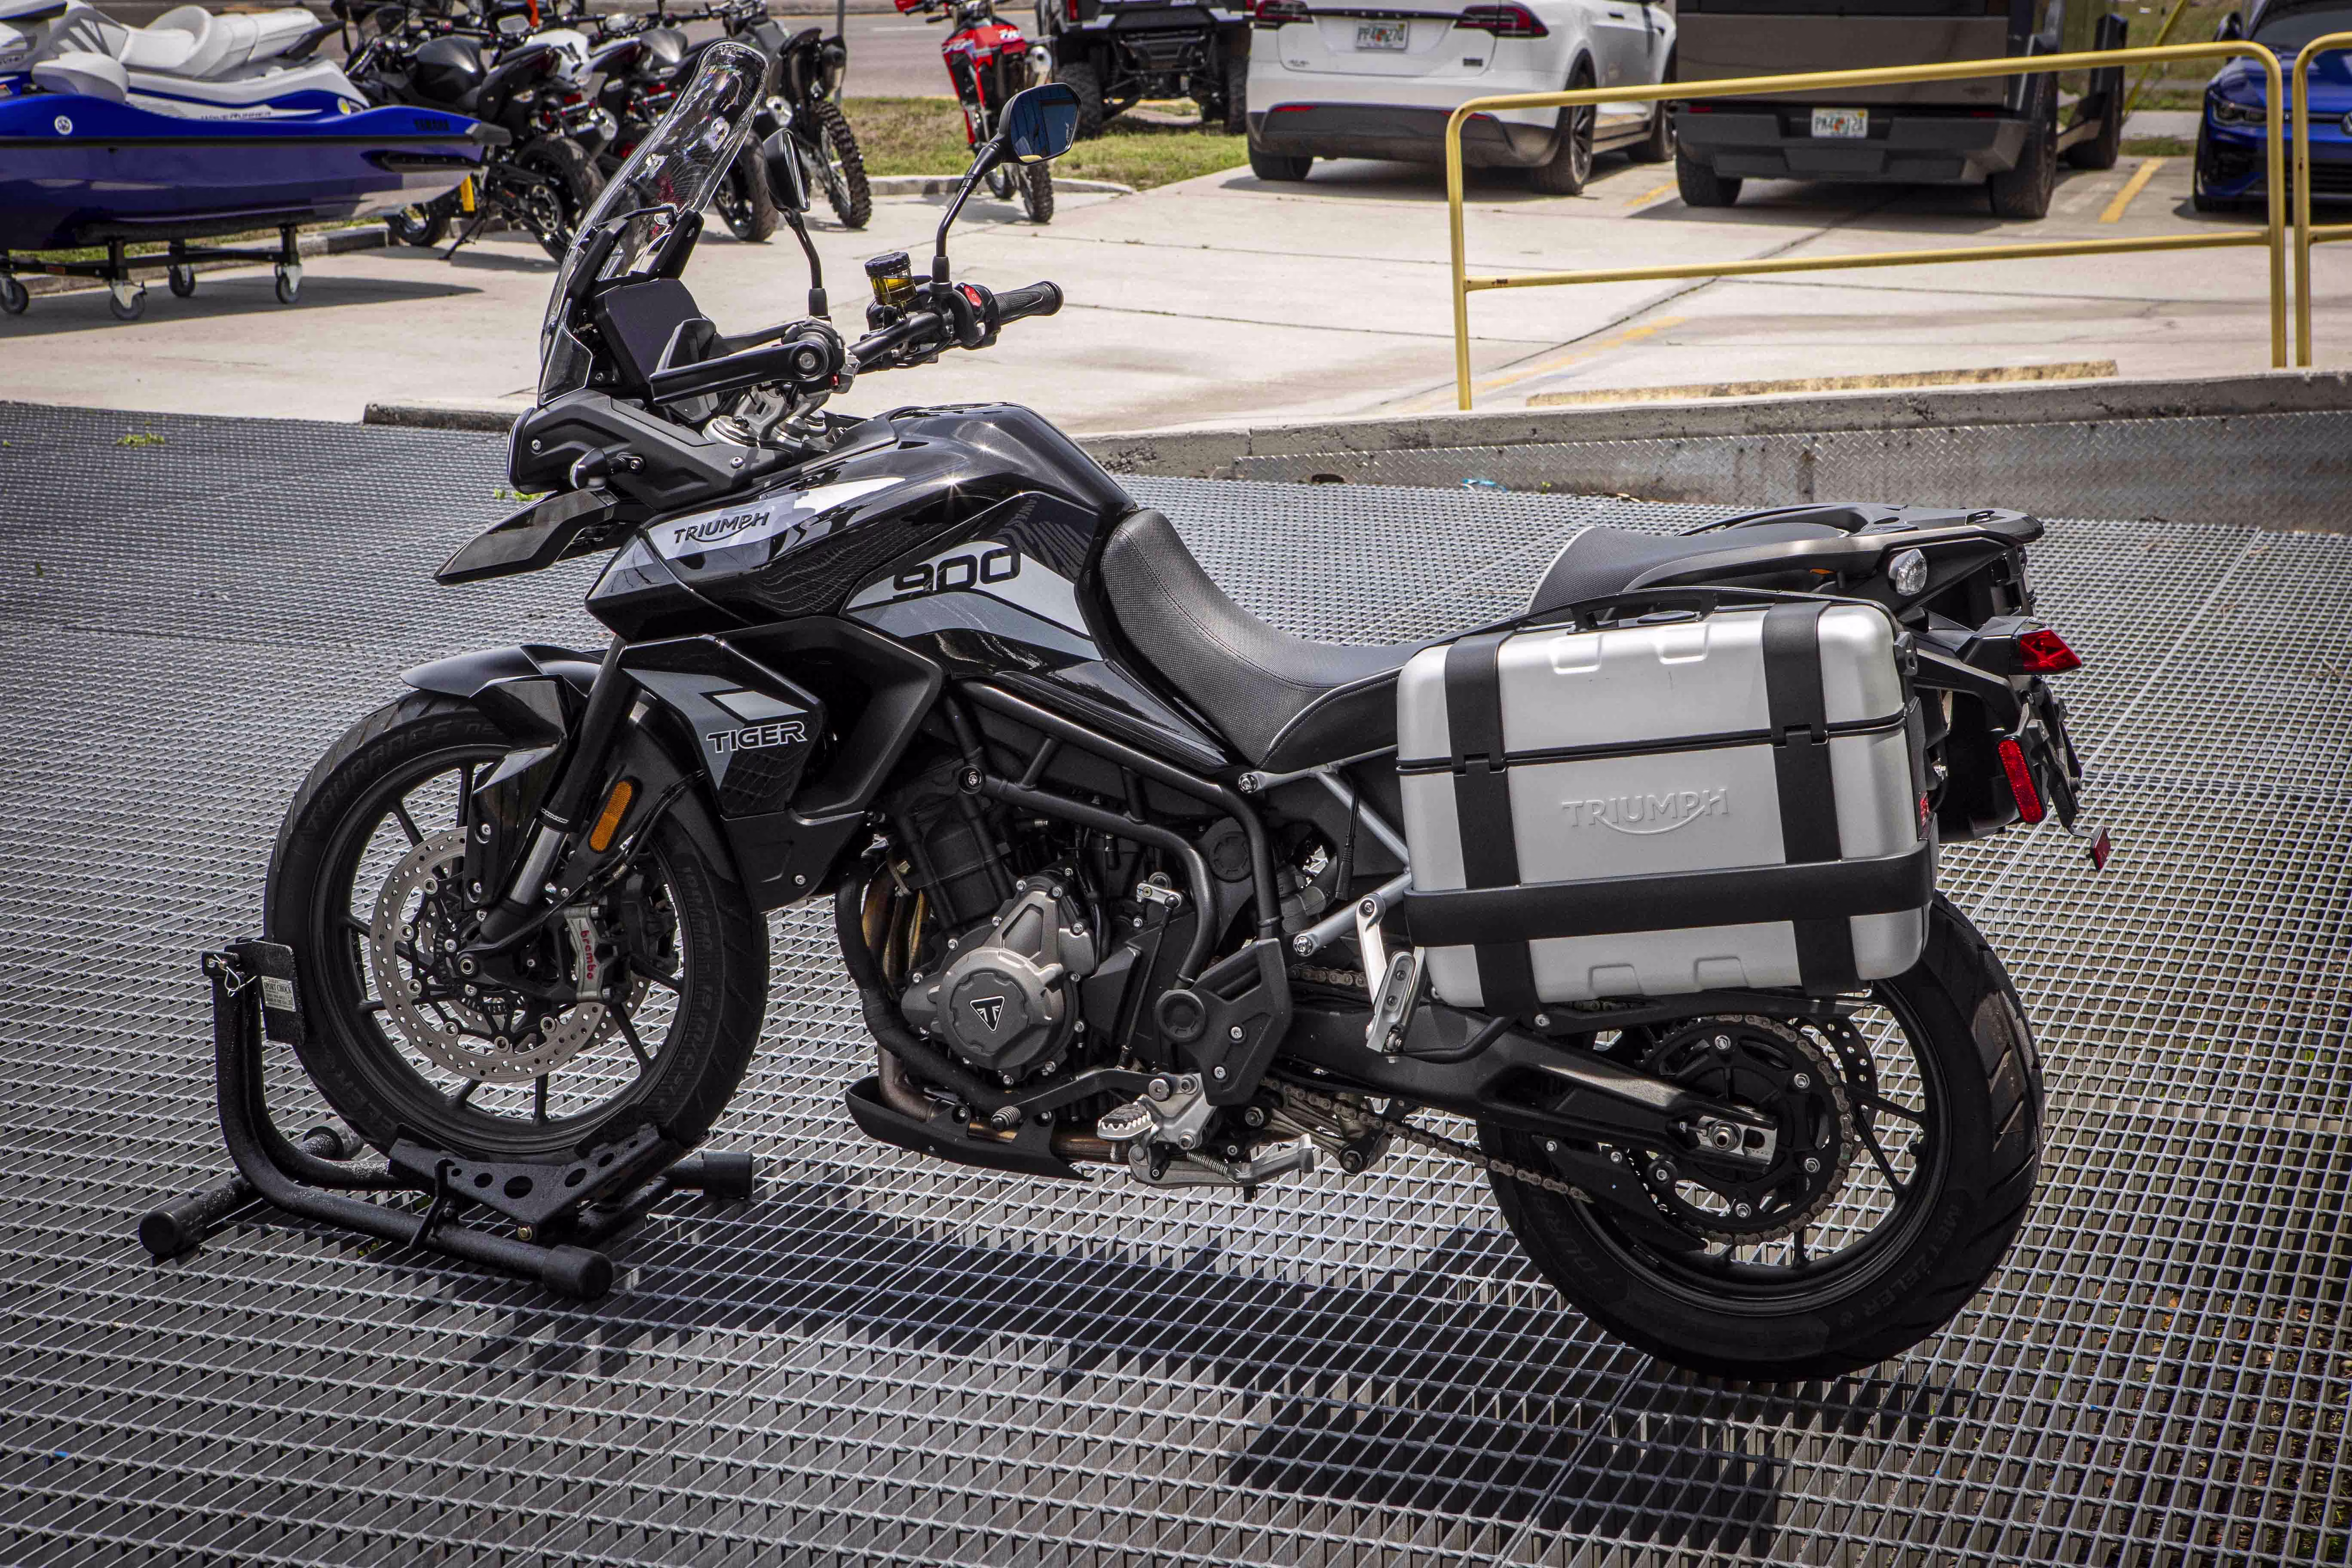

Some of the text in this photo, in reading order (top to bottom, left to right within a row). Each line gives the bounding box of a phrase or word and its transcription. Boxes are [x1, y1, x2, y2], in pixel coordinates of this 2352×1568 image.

[674, 511, 769, 545] TRIUMPH
[893, 546, 1021, 598] 900
[706, 721, 808, 753] TIGER
[1562, 788, 1729, 830] TRIUMPH
[580, 930, 598, 980] brembo
[264, 982, 276, 991] SPORT
[277, 985, 292, 994] CHOCK
